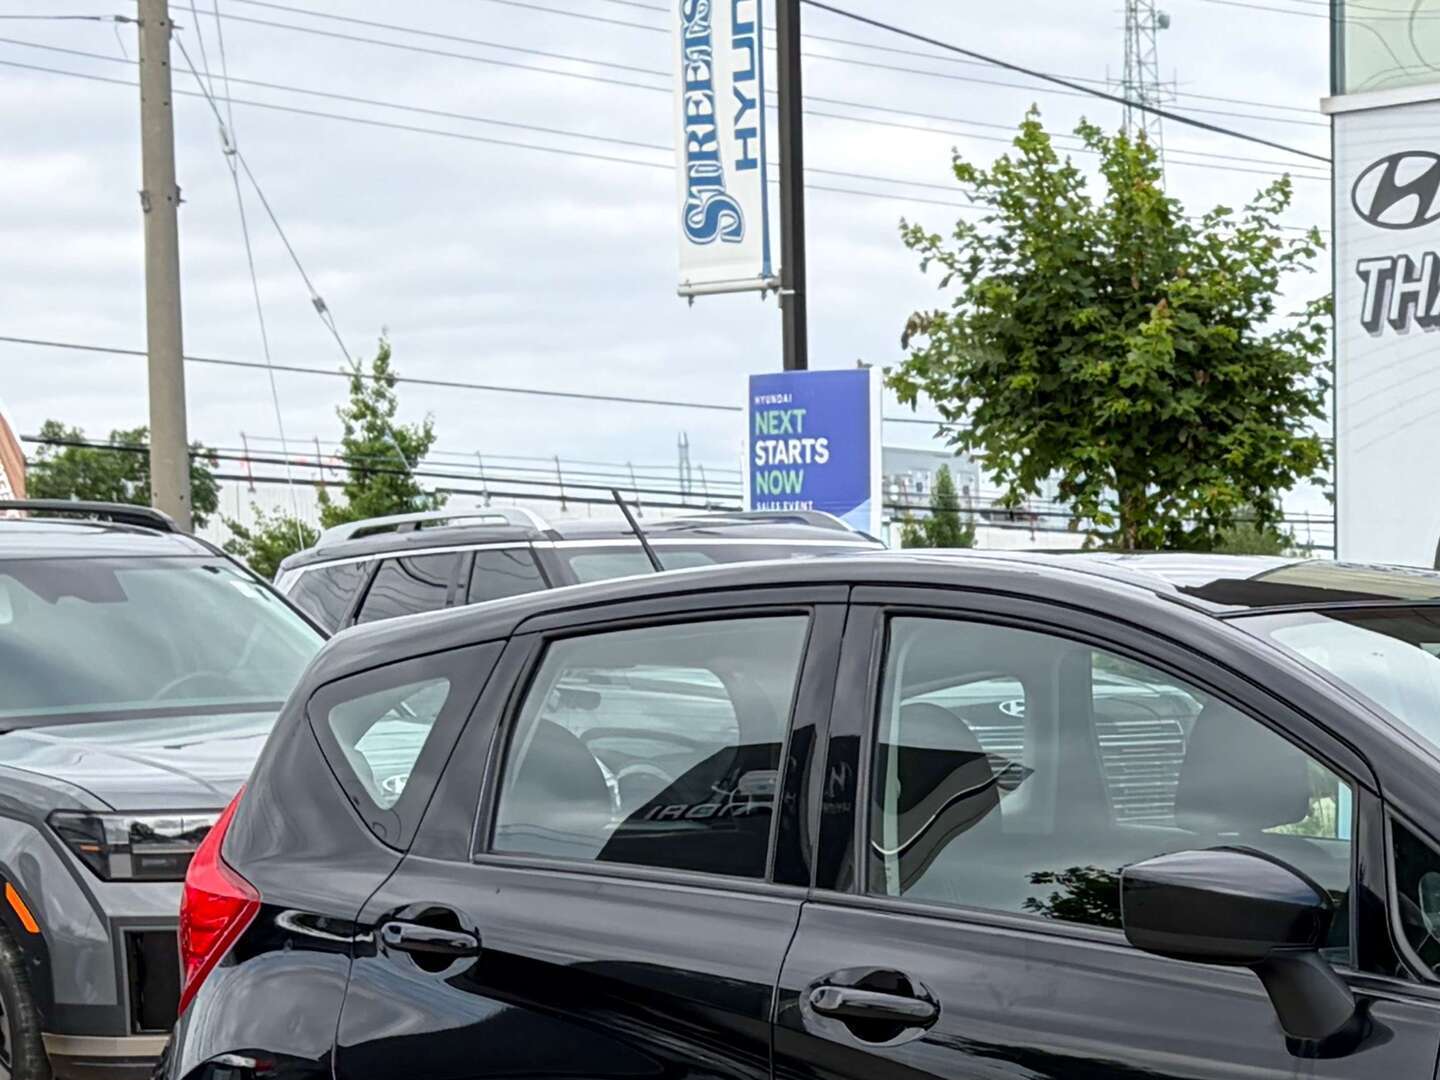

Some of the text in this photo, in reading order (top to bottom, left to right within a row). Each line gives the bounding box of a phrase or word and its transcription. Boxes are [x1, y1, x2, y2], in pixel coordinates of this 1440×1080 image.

[755, 408, 806, 435] NEXT
[755, 437, 830, 466] STARTS
[756, 469, 804, 495] NOW
[783, 500, 814, 511] EVENT
